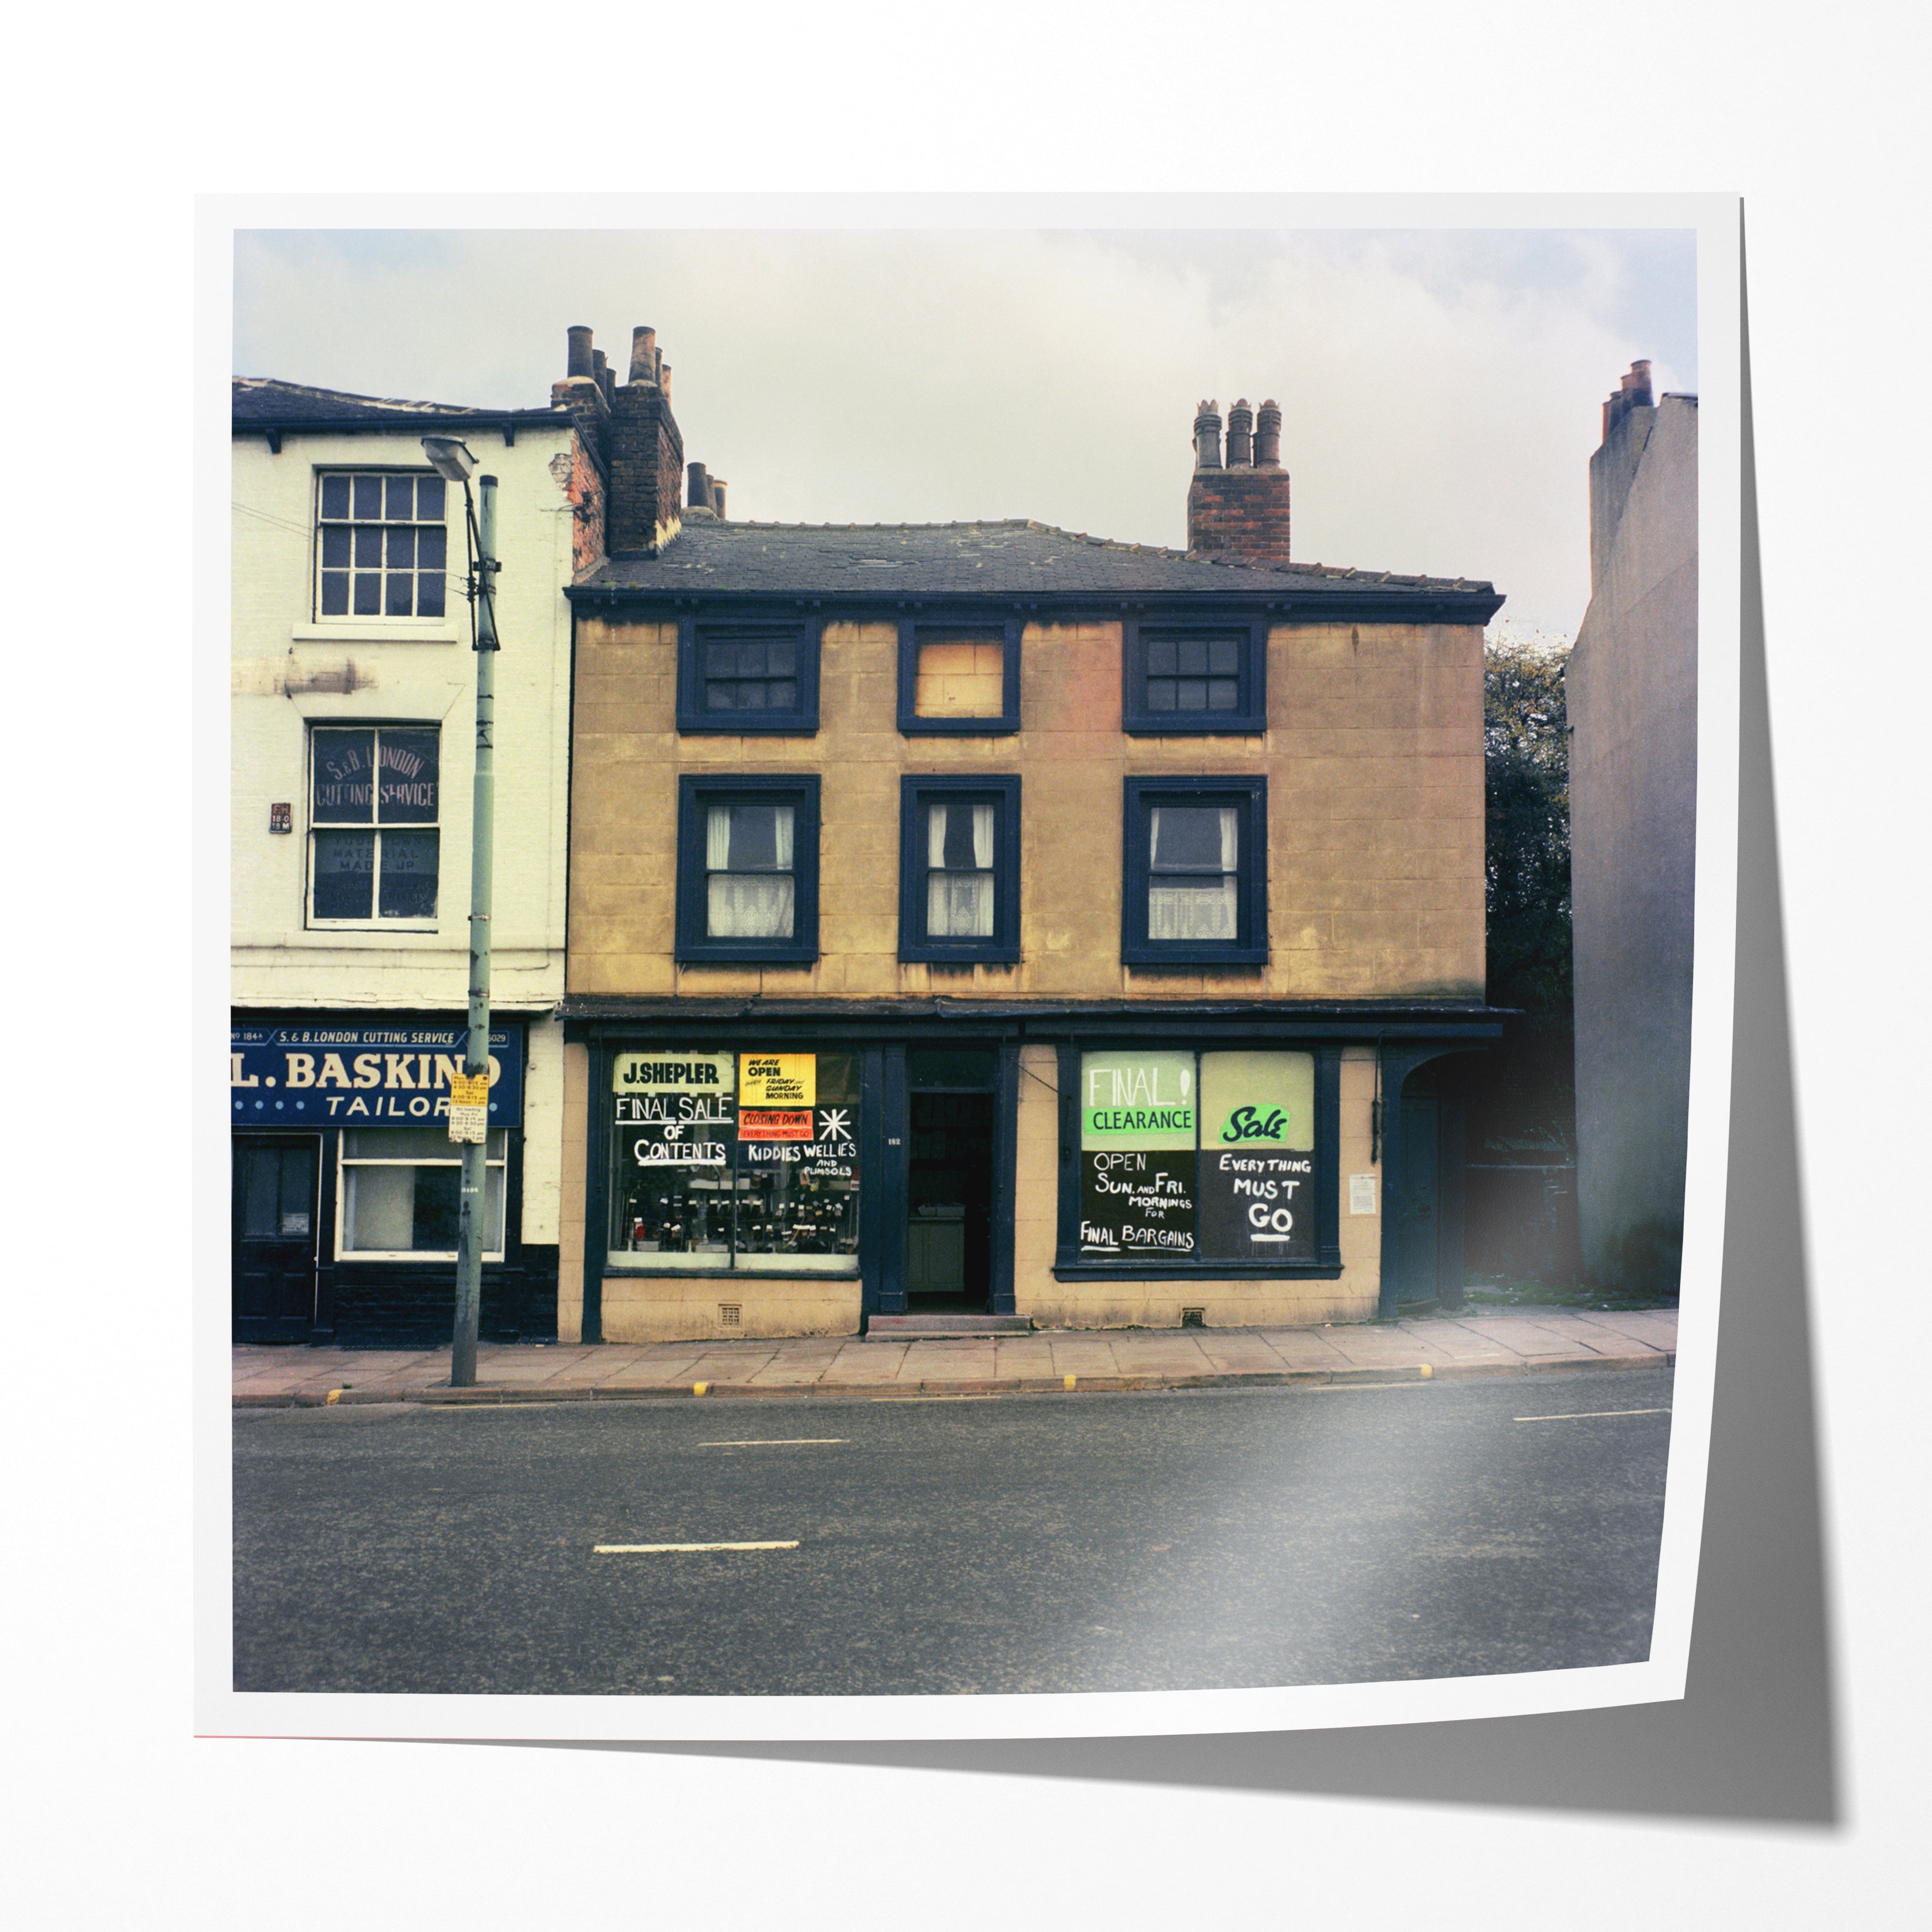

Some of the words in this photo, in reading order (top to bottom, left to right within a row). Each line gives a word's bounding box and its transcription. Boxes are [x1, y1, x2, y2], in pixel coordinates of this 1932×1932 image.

[333, 848, 419, 859] MATERIAL
[340, 860, 388, 870] MADE
[397, 861, 414, 870] UP
[363, 1032, 407, 1043] CUTTING
[411, 1032, 454, 1043] SERVICE
[231, 1053, 276, 1087] L.
[748, 1067, 781, 1076] OPEN
[616, 1098, 676, 1120] FINAL
[678, 1097, 733, 1120] SALE
[744, 1113, 779, 1125] CLOSING
[782, 1114, 808, 1125] DOWN
[1093, 1111, 1192, 1130] CLEARANCE
[664, 1125, 685, 1140] OF
[634, 1139, 727, 1161] CONTENTS
[748, 1144, 801, 1162] KIDDIES
[803, 1143, 856, 1157] WELLIES
[816, 1159, 837, 1167] AND
[1094, 1153, 1146, 1171] OPEN
[804, 1166, 852, 1176] PLIMSOLS
[1137, 1185, 1155, 1194] AND
[1234, 1178, 1300, 1200] MUST
[1128, 1195, 1193, 1210] MORNINGS
[1145, 1207, 1165, 1220] FOR
[1248, 1203, 1293, 1232] GO
[1080, 1220, 1119, 1246] FINAL
[1122, 1225, 1194, 1249] BARGAINS
